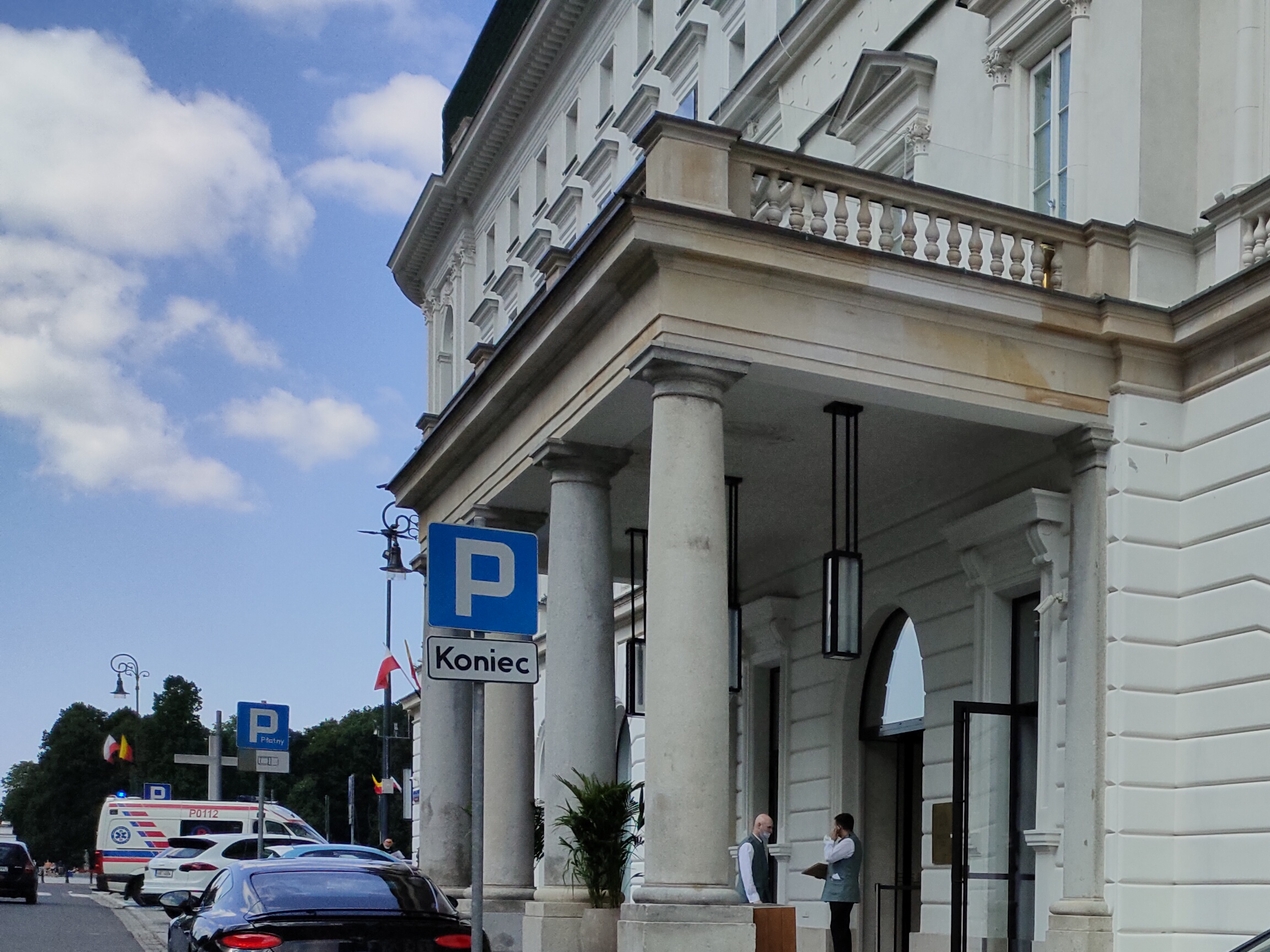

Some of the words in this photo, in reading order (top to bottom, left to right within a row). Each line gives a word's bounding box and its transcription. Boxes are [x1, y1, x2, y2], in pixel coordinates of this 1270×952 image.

[455, 537, 516, 617] P
[435, 645, 530, 675] Koniec
[249, 707, 279, 743] P
[150, 786, 166, 801] P
[188, 808, 219, 819] P0112
